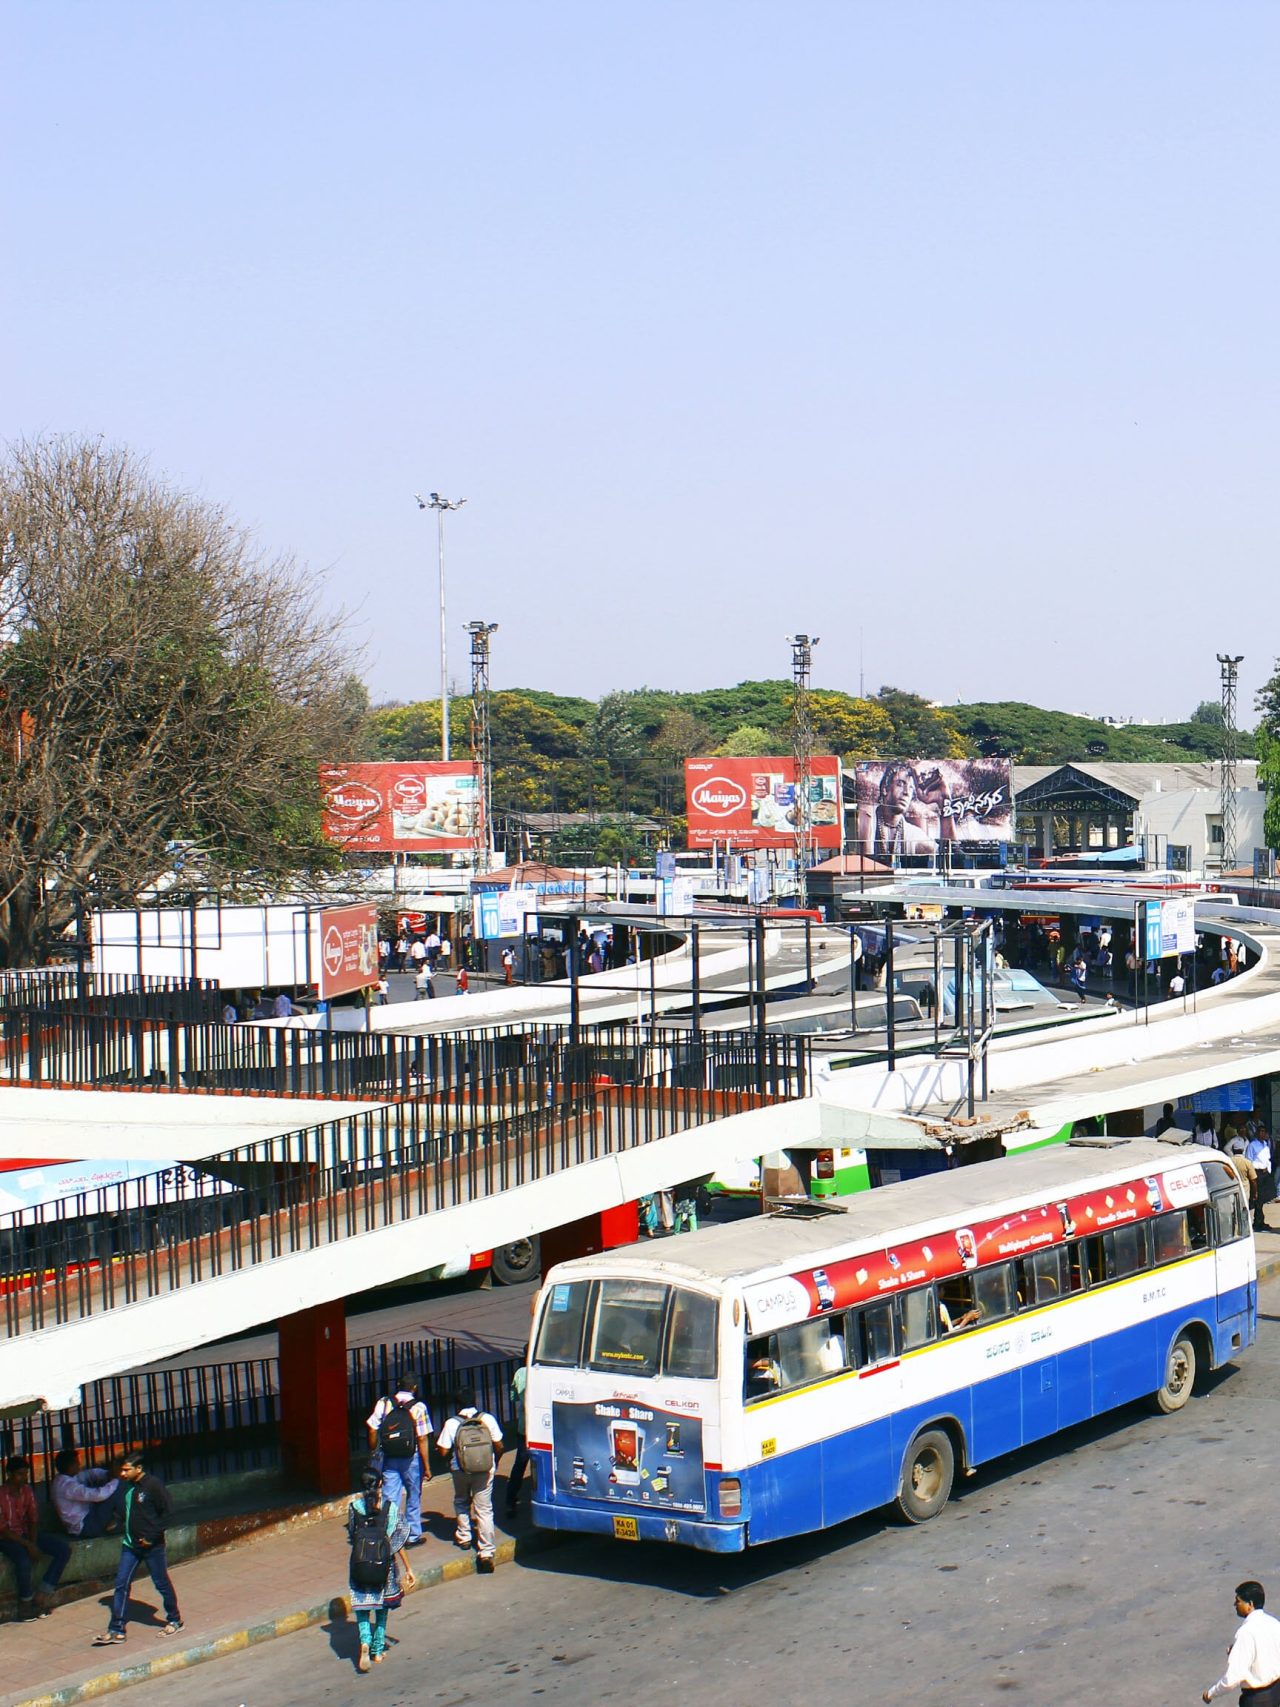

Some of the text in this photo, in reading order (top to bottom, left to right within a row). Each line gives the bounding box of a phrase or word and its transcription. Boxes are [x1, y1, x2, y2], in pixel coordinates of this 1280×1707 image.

[333, 794, 377, 811] Maiyas
[698, 790, 741, 808] Maiyas
[484, 910, 499, 938] 10
[1149, 923, 1160, 957] 11
[1169, 1175, 1206, 1192] CELKON
[878, 1276, 899, 1290] Shake
[907, 1269, 926, 1283] Share
[756, 1289, 796, 1313] CAMPUS
[594, 1403, 621, 1418] Shake
[628, 1406, 654, 1421] Share
[664, 1399, 700, 1409] CELKON
[616, 1520, 634, 1529] KA 01
